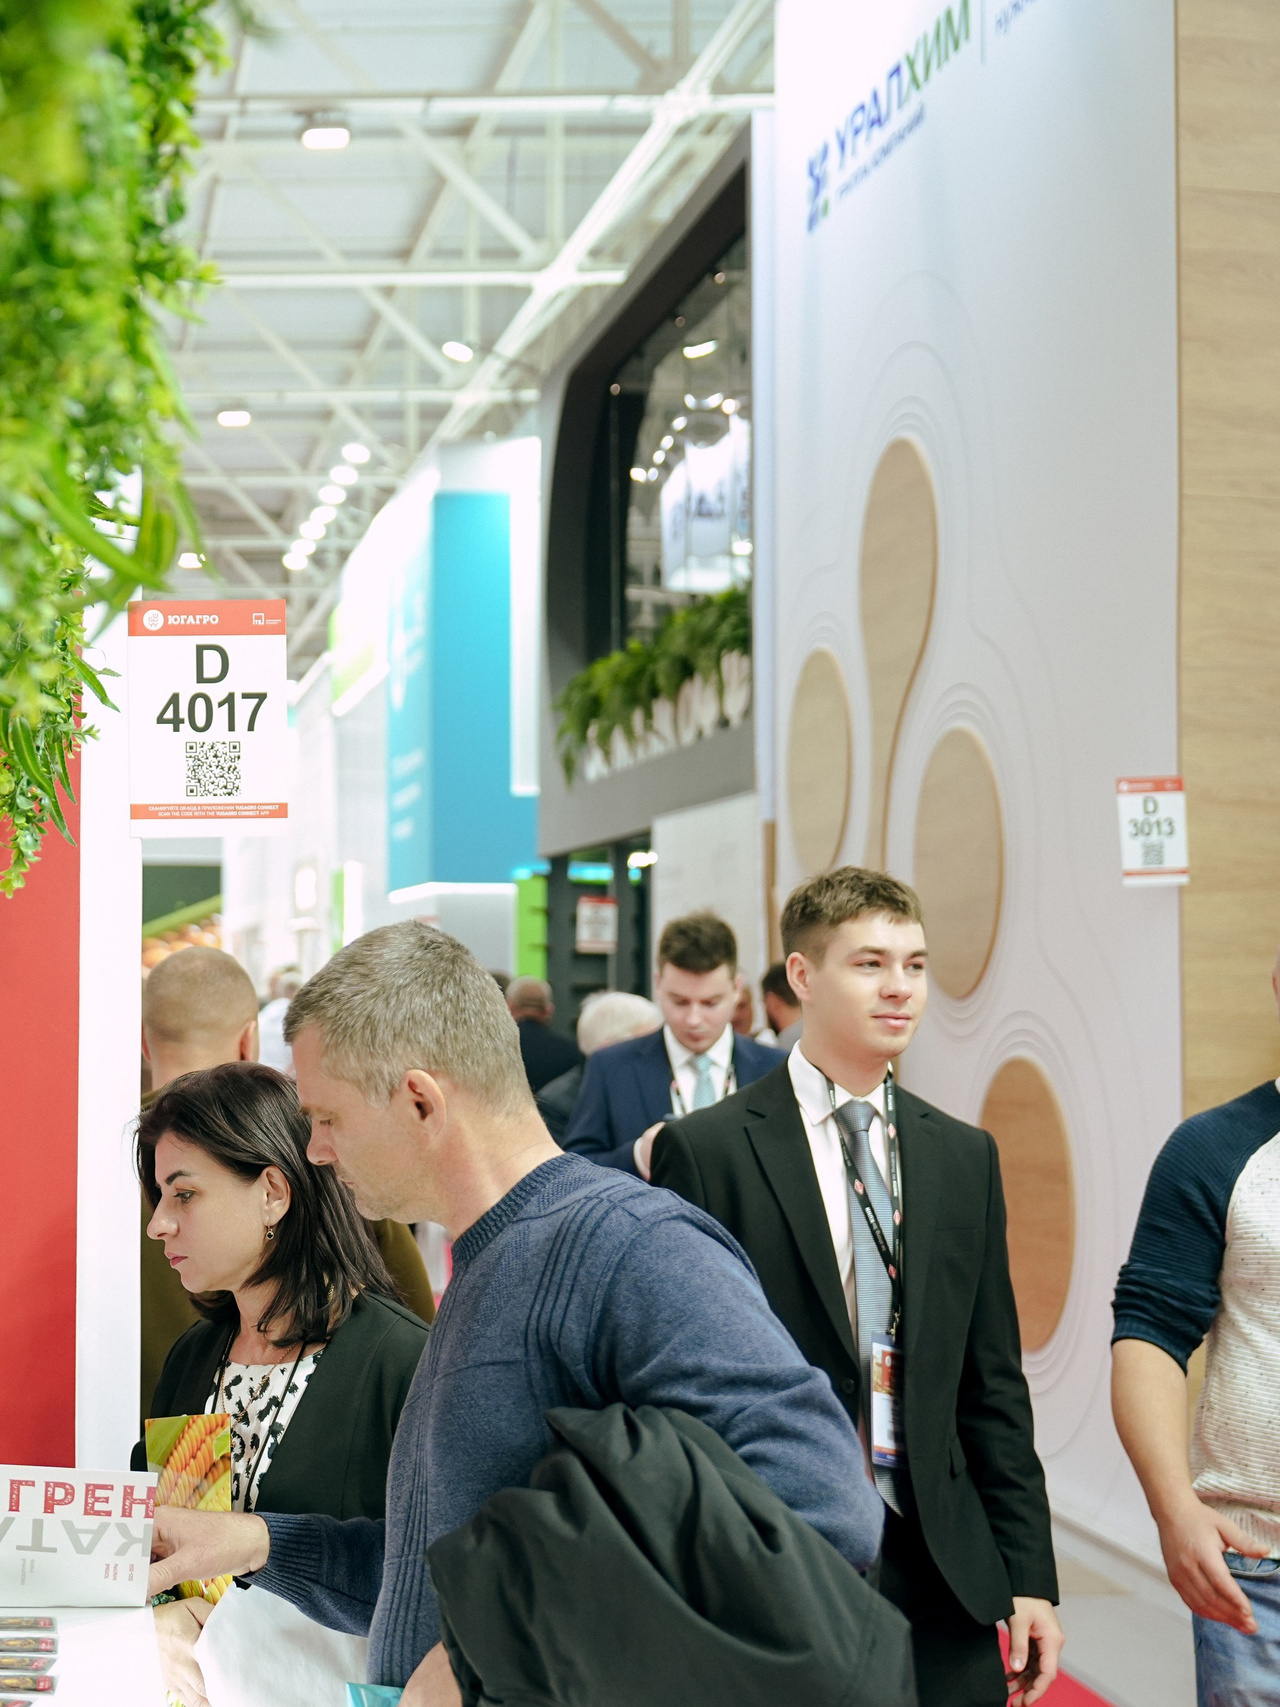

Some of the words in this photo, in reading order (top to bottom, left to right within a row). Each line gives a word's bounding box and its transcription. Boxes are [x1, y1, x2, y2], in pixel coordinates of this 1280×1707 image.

[835, 0, 970, 171] УРАЛХИМ
[167, 614, 219, 625] ЮГАГРО
[195, 643, 230, 684] D
[156, 692, 268, 732] 4017
[1142, 795, 1159, 815] D
[1128, 817, 1176, 838] 3013
